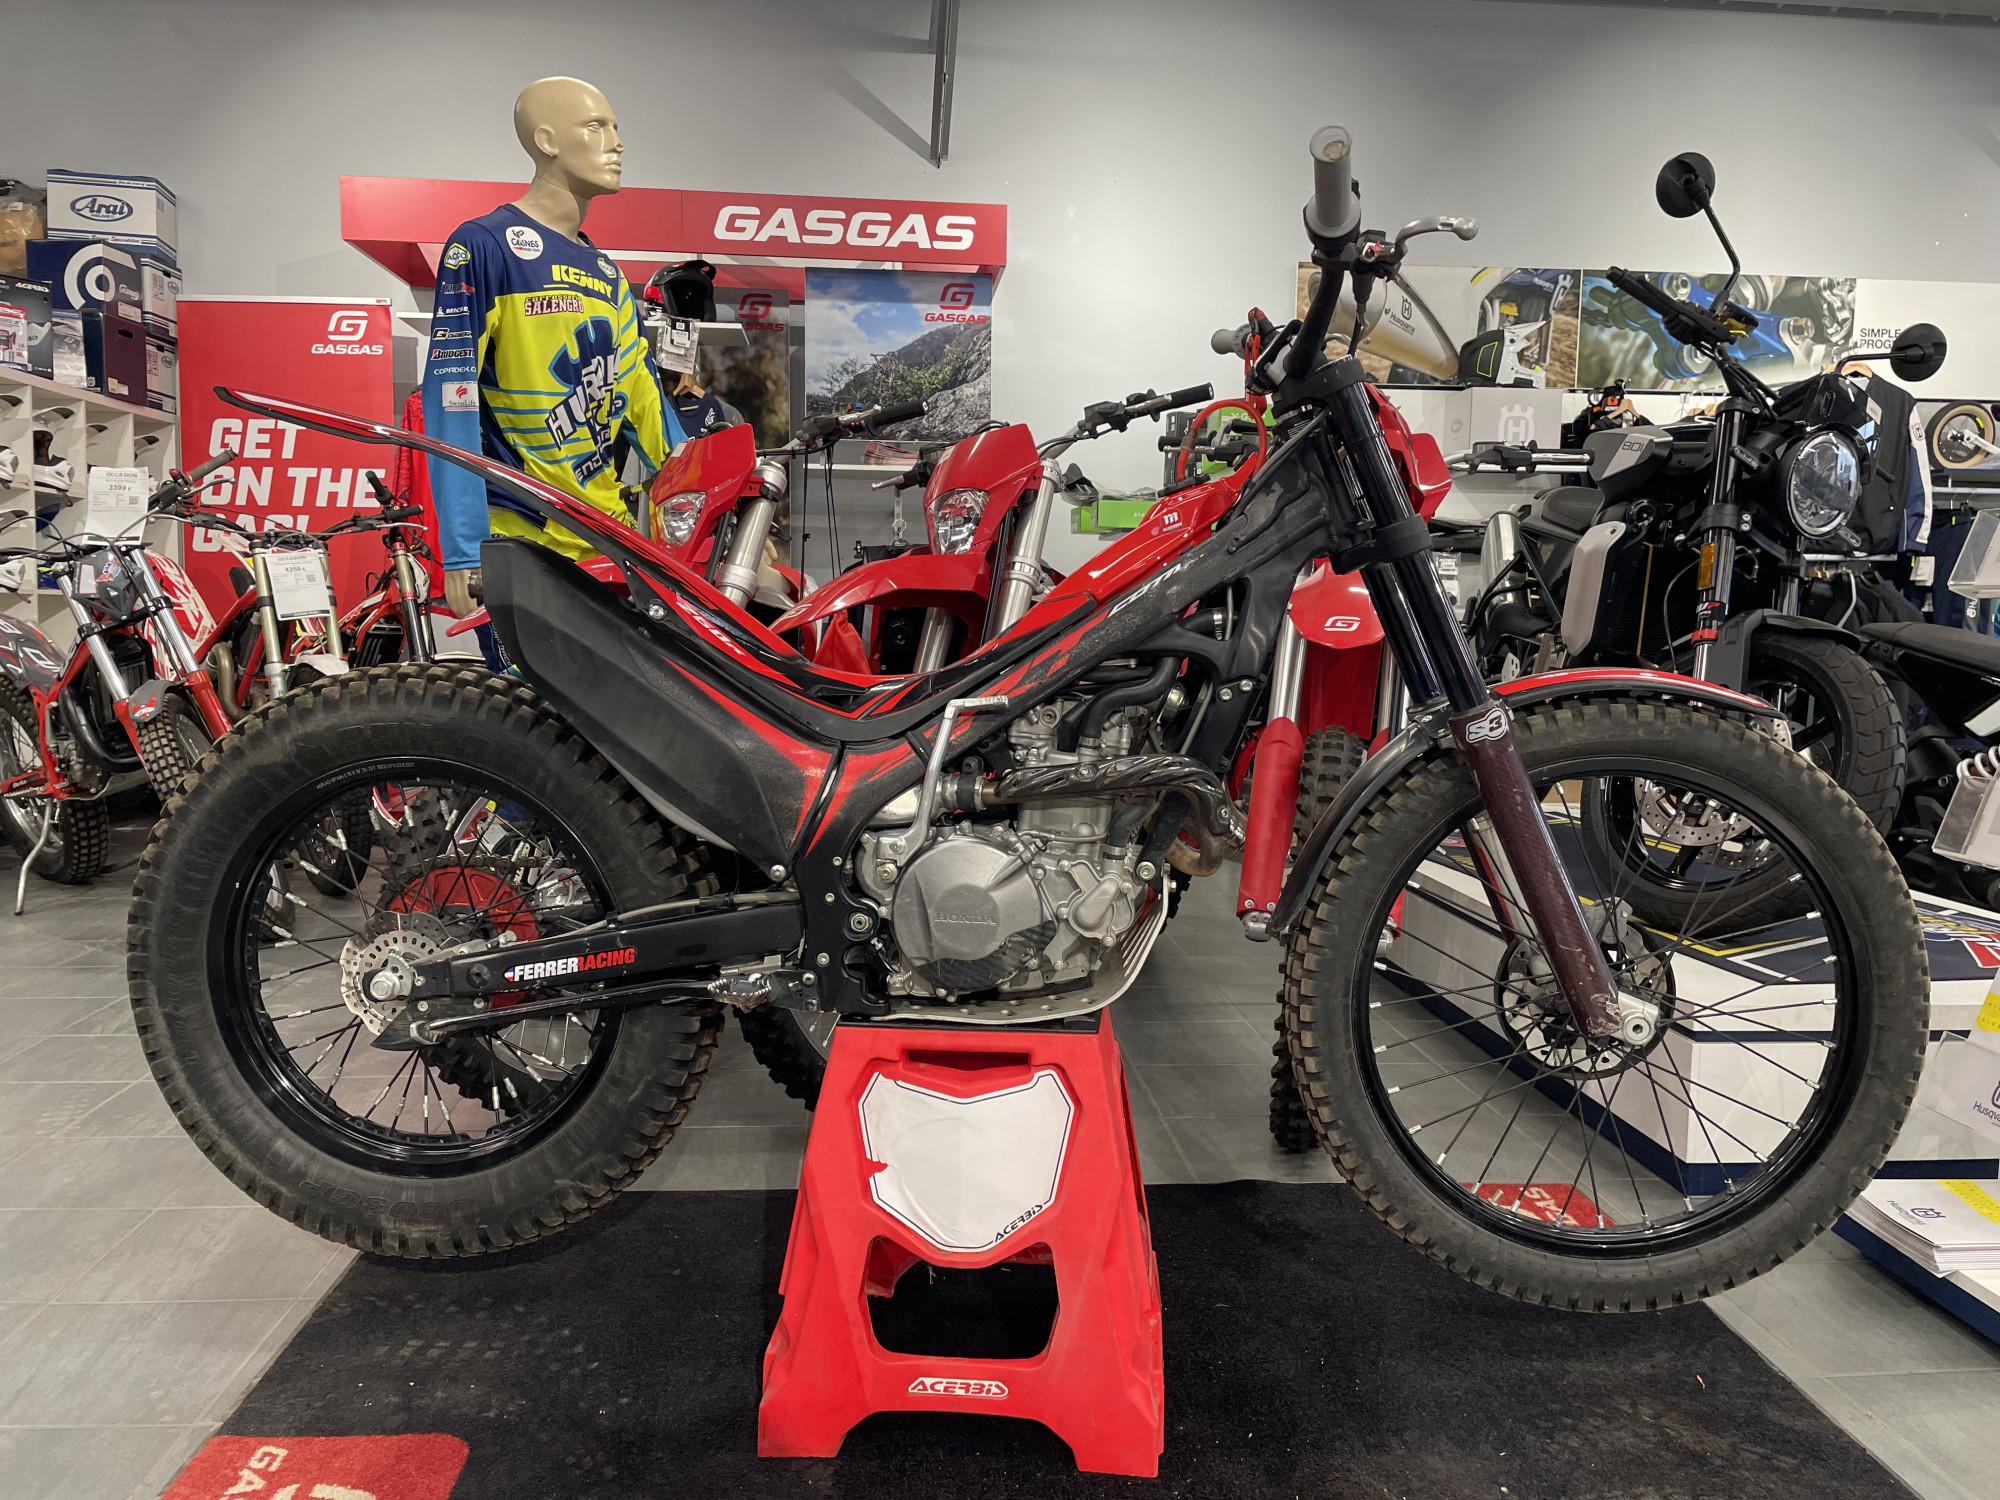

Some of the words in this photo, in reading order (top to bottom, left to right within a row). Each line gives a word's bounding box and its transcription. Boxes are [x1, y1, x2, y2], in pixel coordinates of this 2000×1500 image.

[74, 197, 127, 216] Arai
[713, 205, 977, 251] GASGAS
[551, 264, 613, 299] KENNY
[524, 299, 585, 316] SALENGRO
[924, 312, 987, 324] GASGAS
[311, 344, 383, 356] GASGAS
[208, 418, 307, 459] GET
[200, 466, 274, 506] ON
[286, 467, 386, 508] THE
[934, 911, 997, 925] HONDA
[995, 1204, 1044, 1243] ACERBIS
[909, 1379, 1008, 1396] ACERBIS
